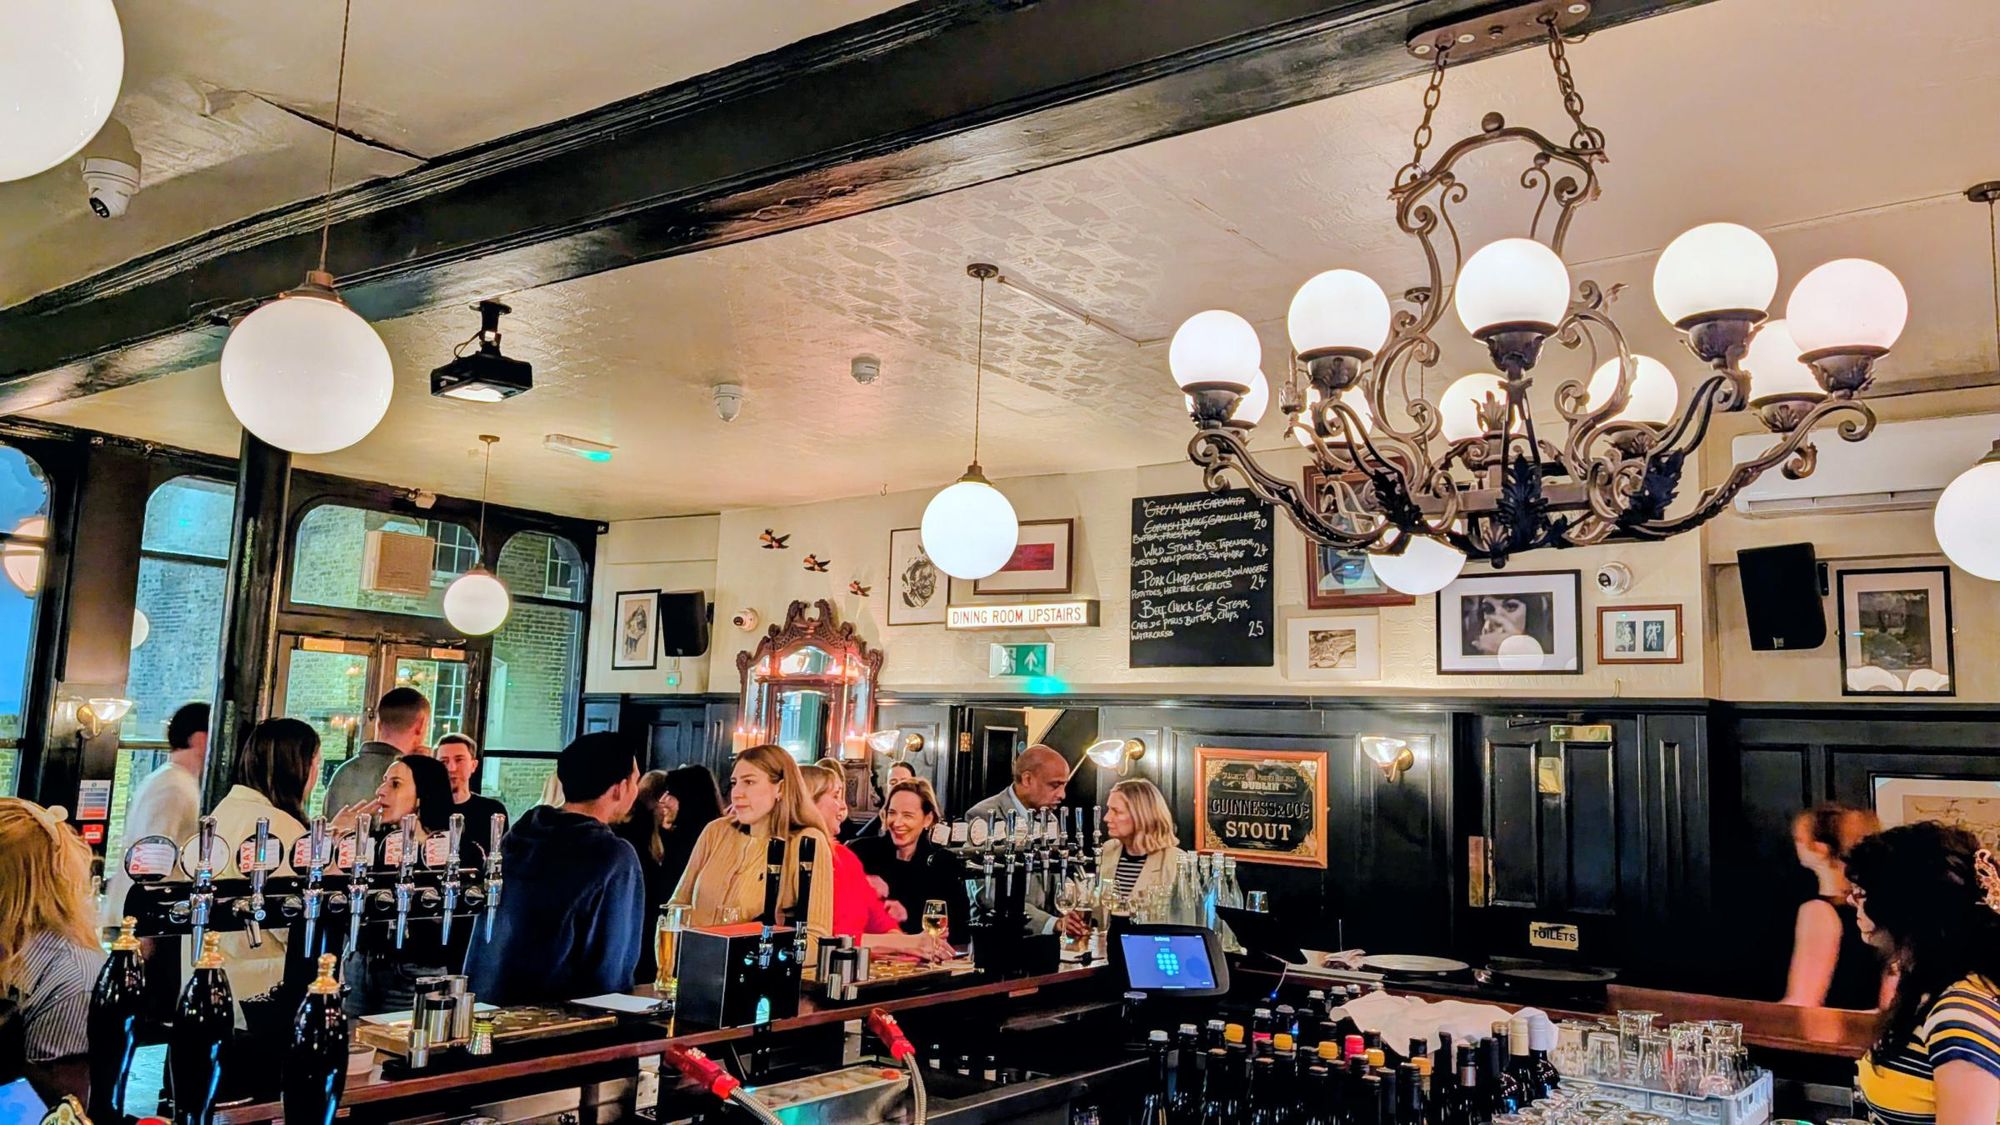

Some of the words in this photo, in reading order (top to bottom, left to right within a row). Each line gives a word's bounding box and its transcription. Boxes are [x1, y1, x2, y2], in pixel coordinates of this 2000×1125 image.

[1253, 518, 1268, 530] 20
[1253, 542, 1269, 558] 24
[1250, 574, 1267, 591] 24
[952, 610, 988, 624] DINING
[992, 609, 1024, 623] ROOM
[1028, 607, 1082, 622] UPSTAIRS
[1248, 620, 1265, 637] 25
[1241, 780, 1280, 791] DUBLIN
[1211, 798, 1277, 818] GUINNESS
[1225, 820, 1292, 841] STOUT
[1532, 928, 1577, 942] TOILETS
